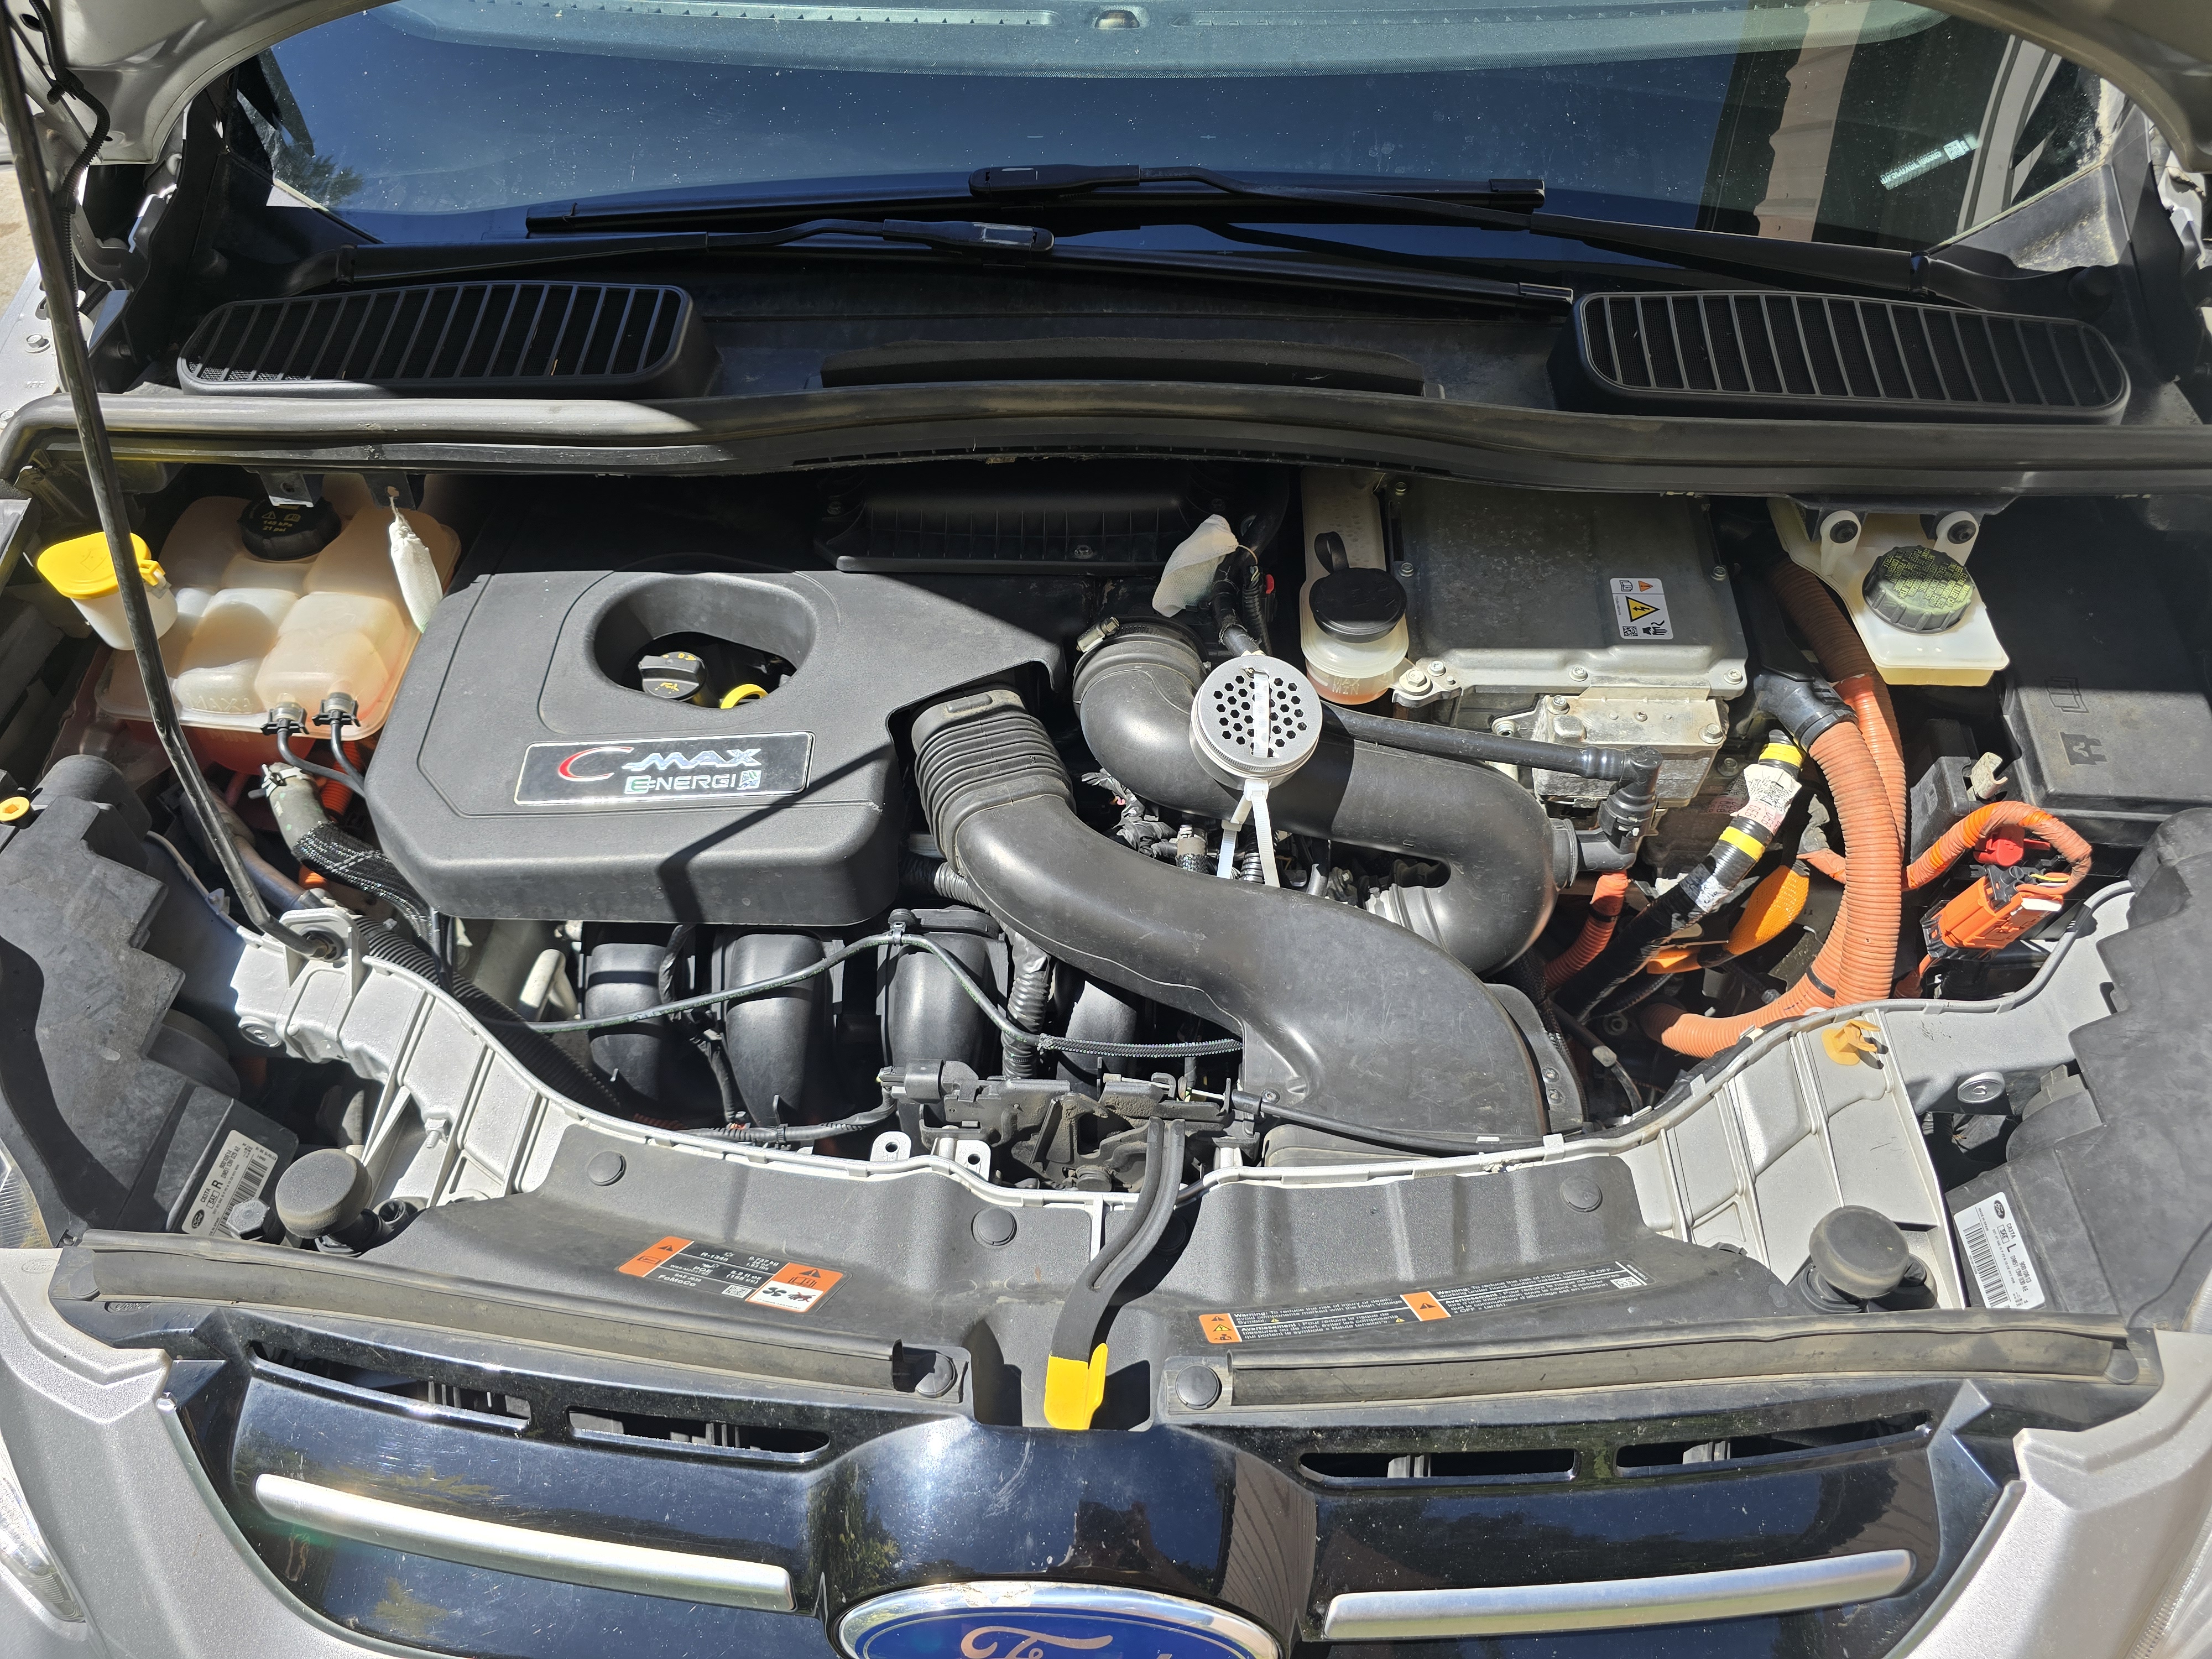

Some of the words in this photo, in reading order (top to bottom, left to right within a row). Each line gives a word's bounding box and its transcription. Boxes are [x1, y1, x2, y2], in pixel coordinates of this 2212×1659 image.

[211, 1180, 223, 1189] R
[208, 1193, 217, 1204] SAE
[1992, 1202, 2005, 1217] Ford
[191, 1211, 204, 1228] Ford
[2007, 1244, 2016, 1252] L
[701, 1253, 728, 1261] R-134a
[2010, 1255, 2018, 1267] DM51
[658, 1275, 696, 1286] FoMoCo
[1446, 1292, 1498, 1304] Avertissement
[1474, 1296, 1517, 1306] commutateur
[1483, 1292, 1522, 1301] intervention
[1241, 1322, 1296, 1331] Avertissement
